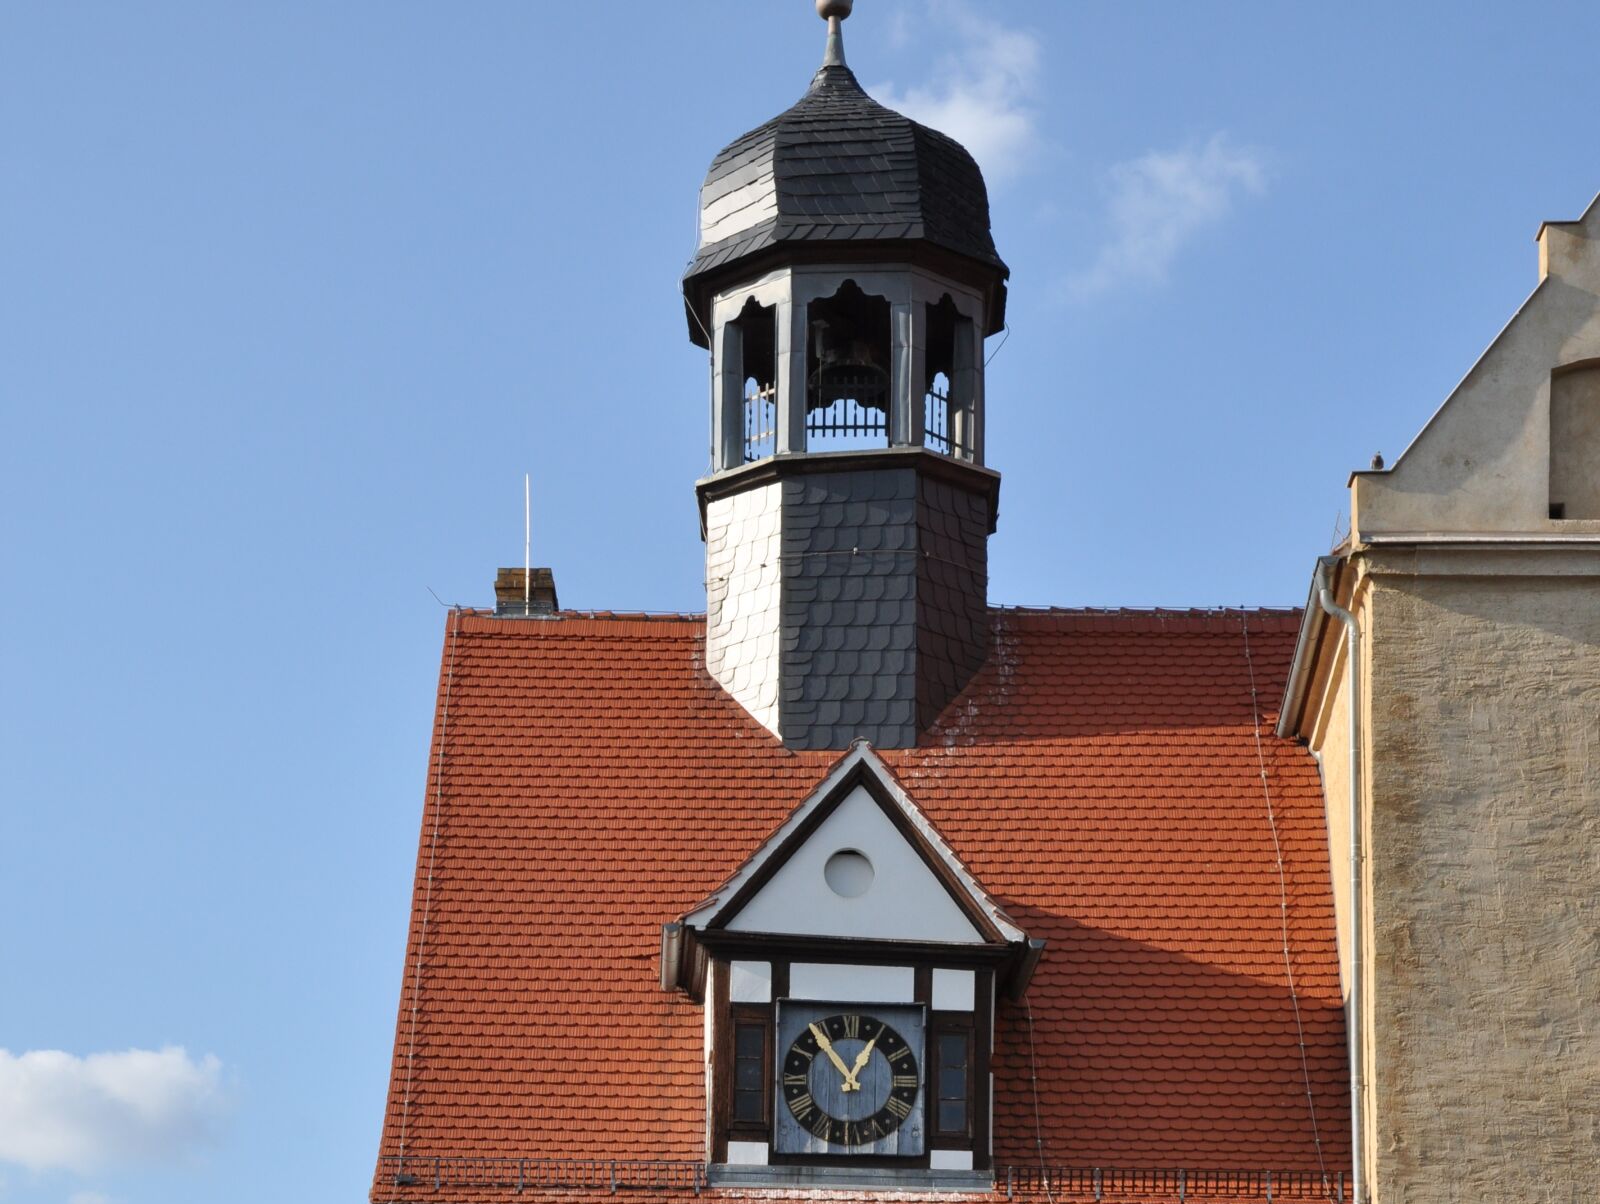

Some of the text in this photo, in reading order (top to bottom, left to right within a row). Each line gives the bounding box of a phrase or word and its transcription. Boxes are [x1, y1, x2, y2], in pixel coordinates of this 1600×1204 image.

[842, 1015, 859, 1038] XII
[888, 1046, 910, 1063] II
[893, 1075, 917, 1088] III
